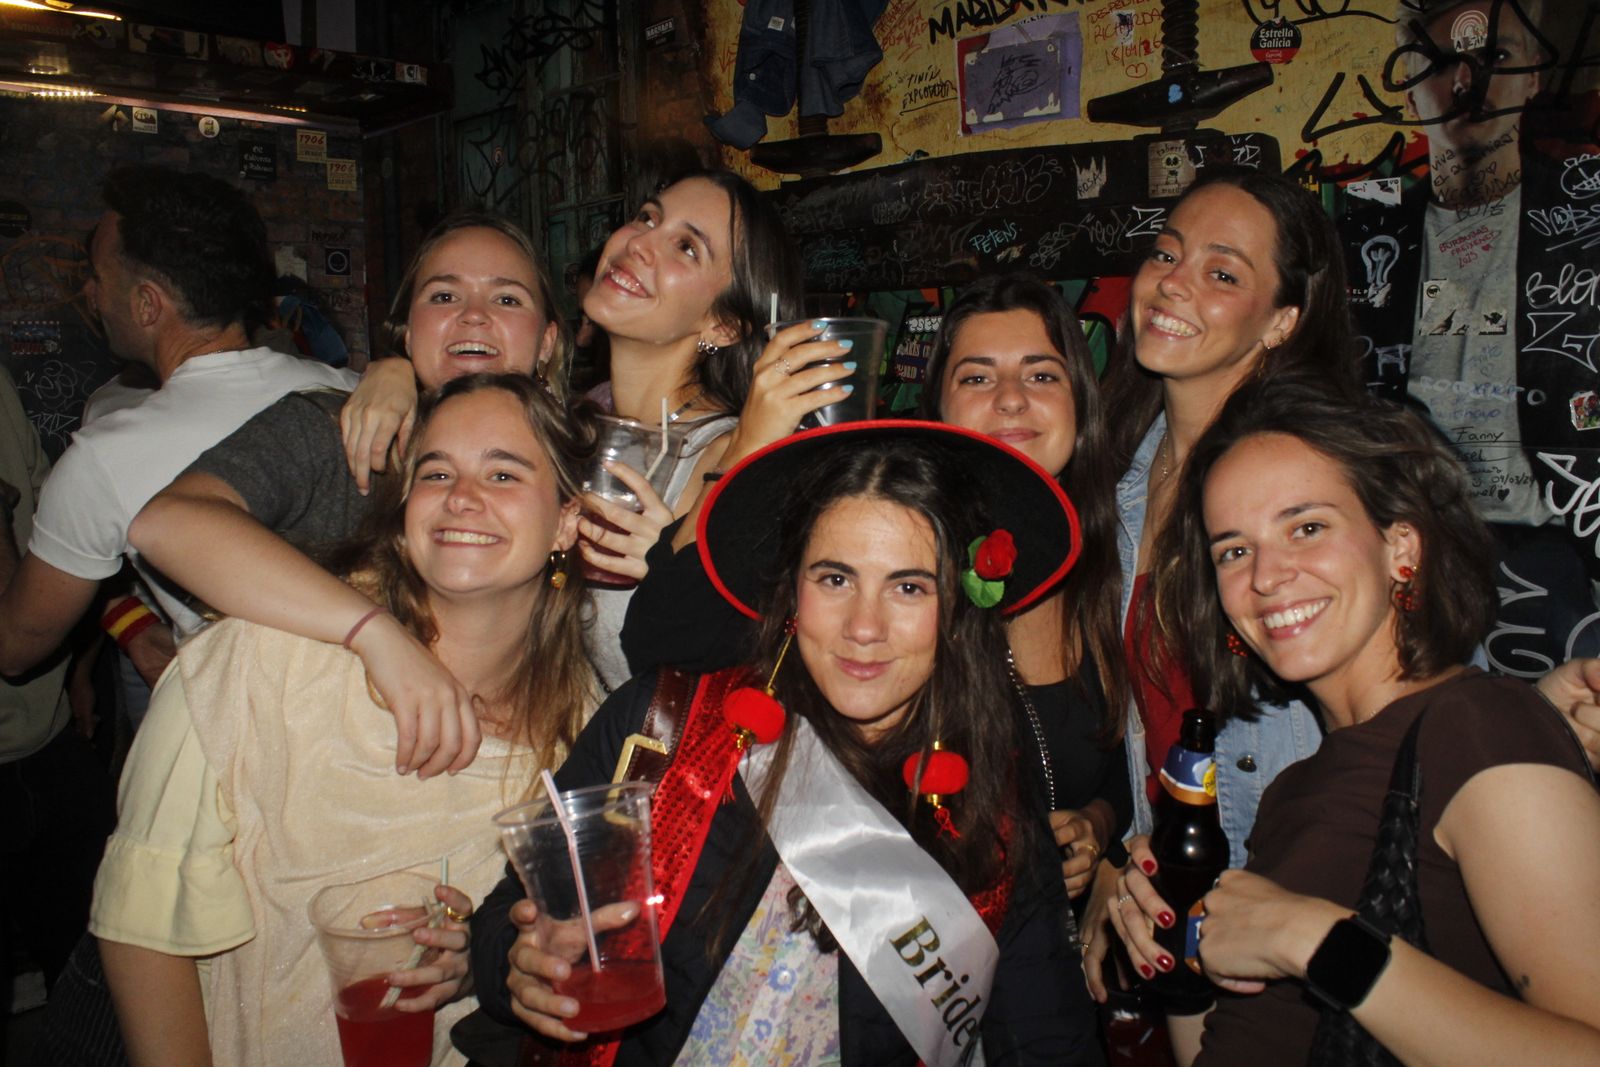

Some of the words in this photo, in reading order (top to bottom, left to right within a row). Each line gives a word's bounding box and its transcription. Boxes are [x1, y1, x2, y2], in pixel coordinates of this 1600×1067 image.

[1259, 28, 1293, 38] Estrella
[1259, 38, 1291, 48] Galicia
[299, 134, 325, 145] 1906
[1451, 426, 1504, 443] Fanny
[889, 914, 981, 1046] Bride
